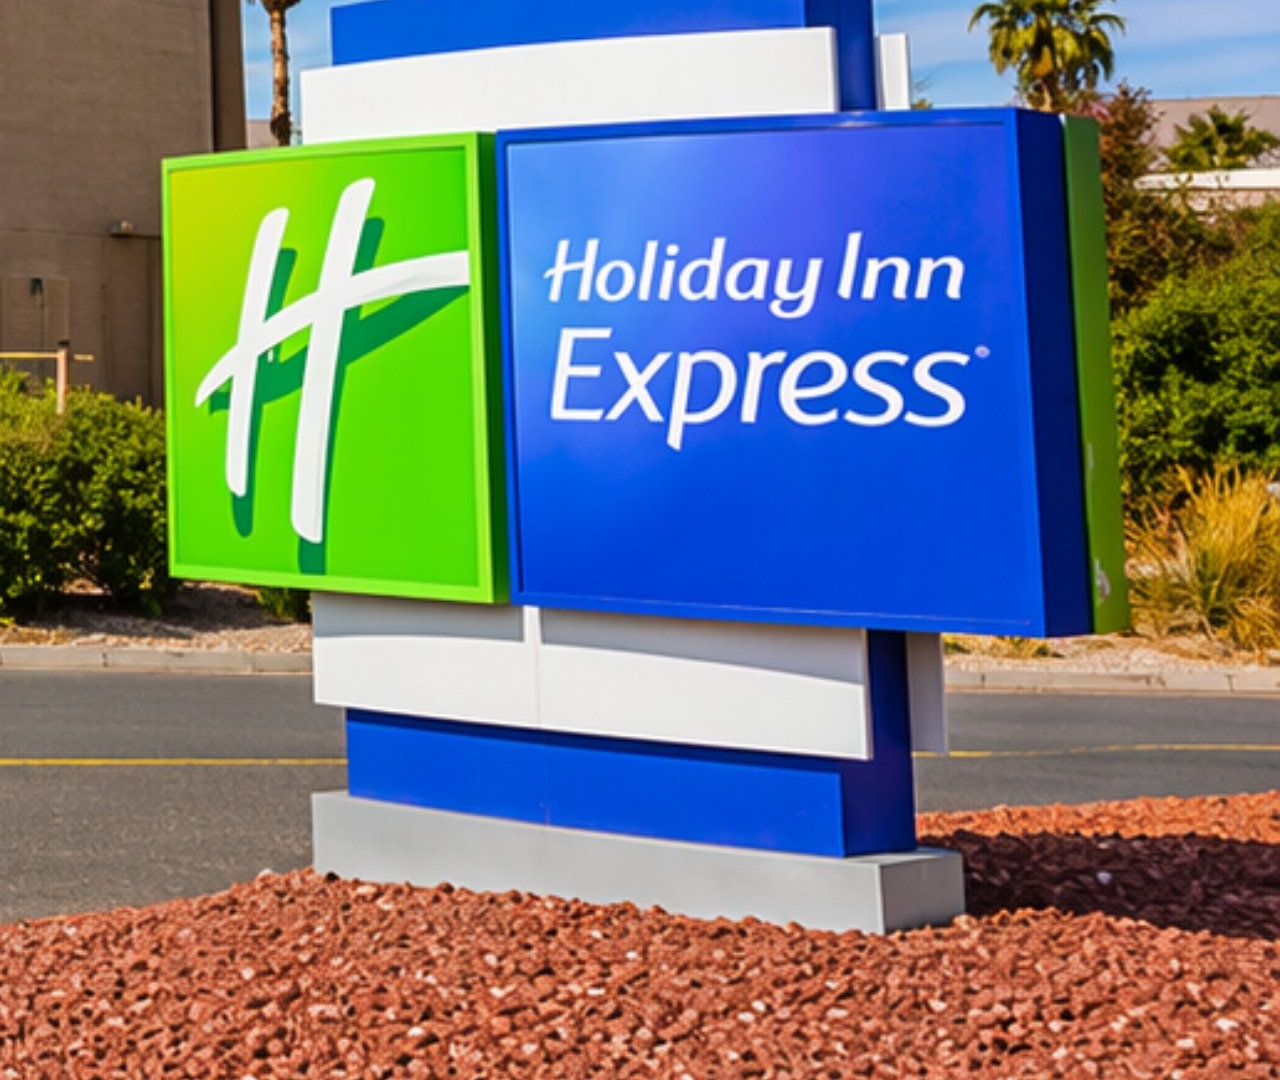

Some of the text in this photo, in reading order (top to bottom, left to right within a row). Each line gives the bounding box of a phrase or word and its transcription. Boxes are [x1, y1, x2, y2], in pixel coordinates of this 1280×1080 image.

[543, 231, 965, 318] Holiday Inn
[549, 328, 971, 451] Express
